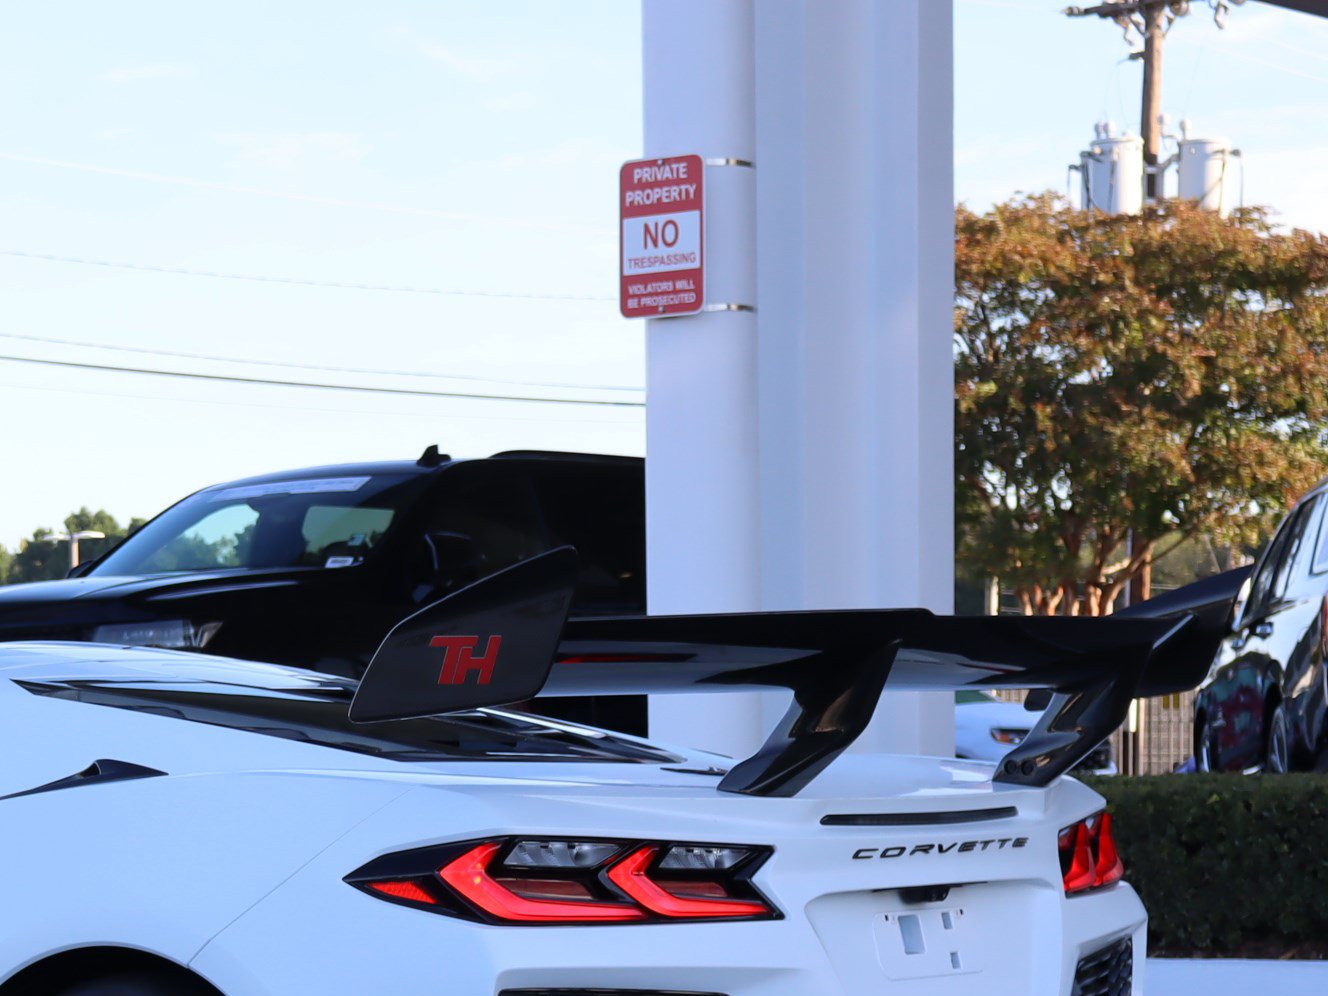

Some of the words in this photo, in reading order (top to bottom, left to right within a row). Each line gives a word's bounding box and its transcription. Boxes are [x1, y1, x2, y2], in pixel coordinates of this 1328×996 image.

[633, 162, 688, 184] PRIVATE
[626, 183, 697, 207] PROPERTY
[643, 219, 679, 250] NO
[628, 252, 696, 269] TRESPASSING
[628, 281, 674, 295] VIOLATORS
[675, 279, 696, 291] WILL
[627, 298, 639, 309] BE
[640, 292, 697, 307] PROSECUTED
[429, 635, 503, 685] TH
[852, 837, 1029, 860] CORVETTE
